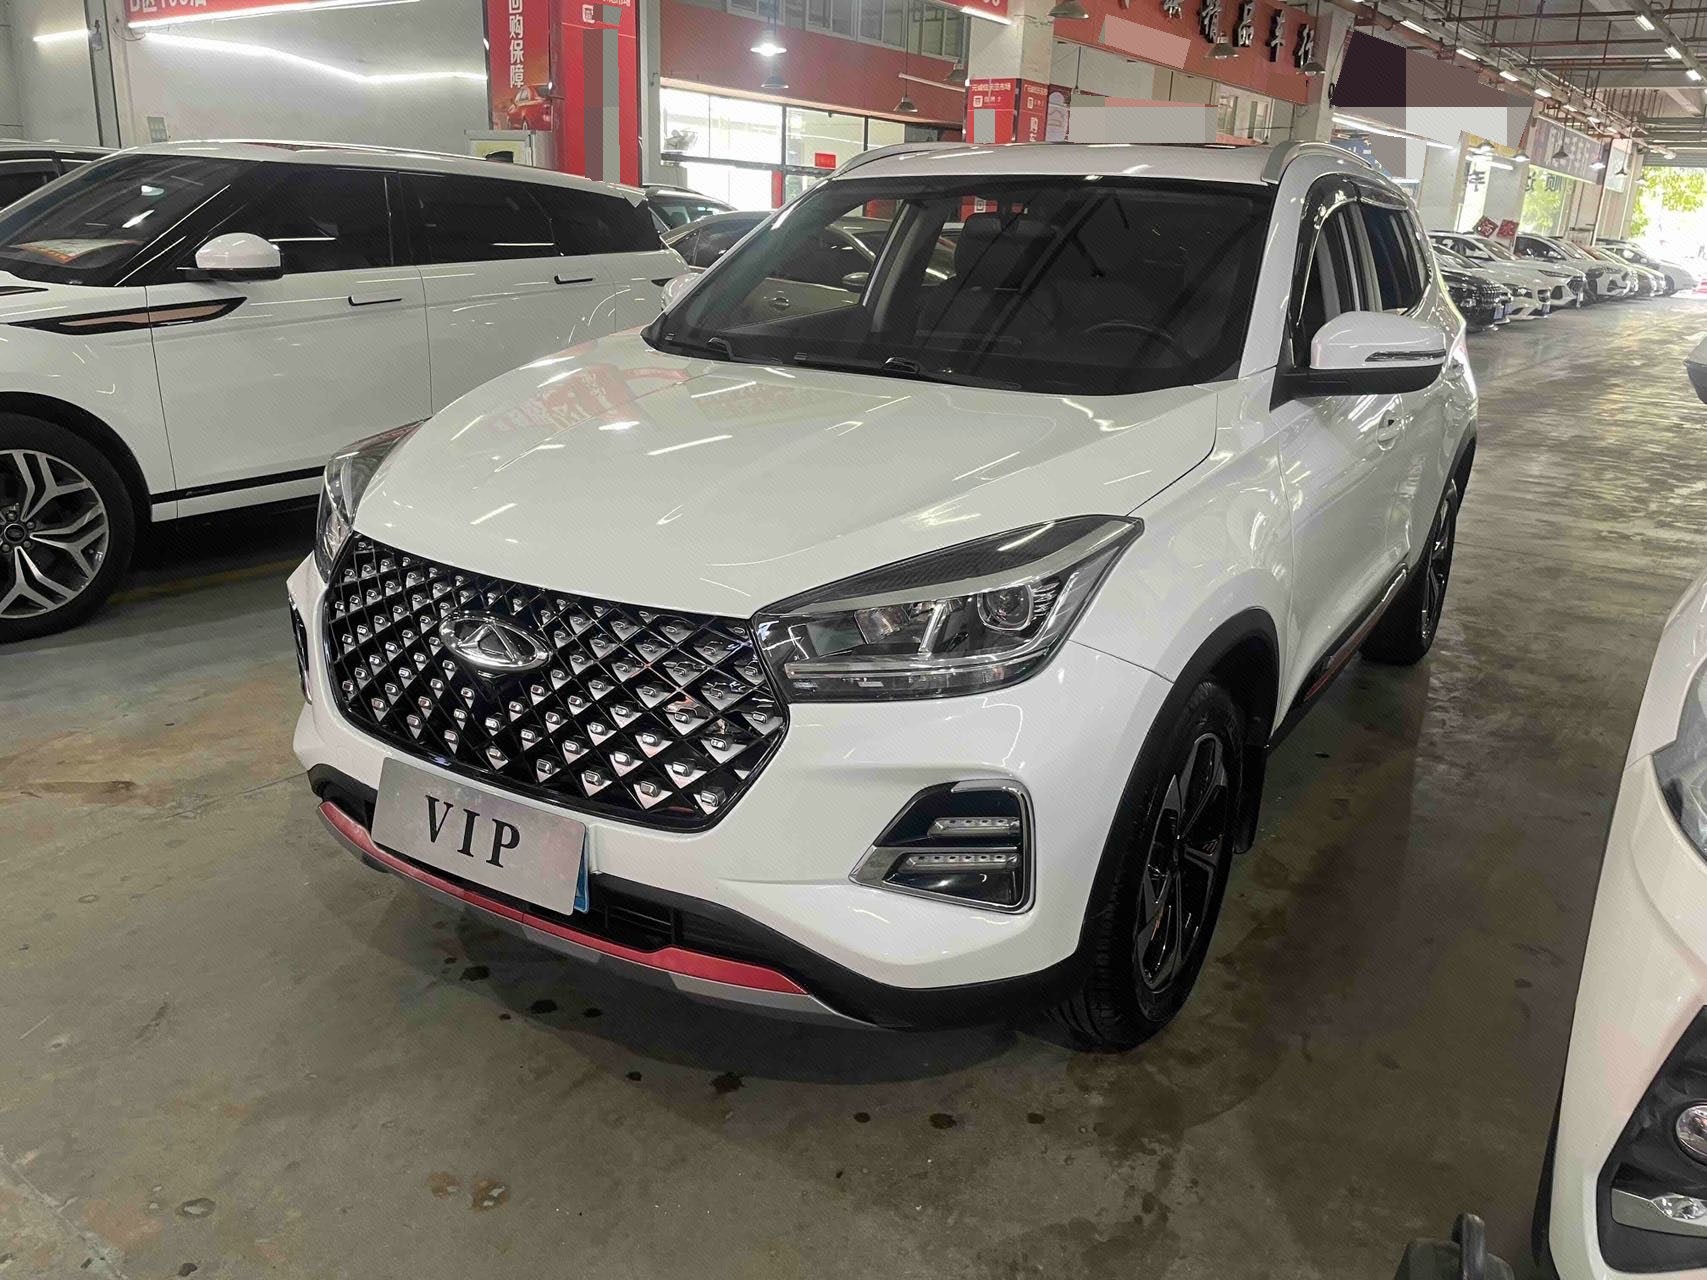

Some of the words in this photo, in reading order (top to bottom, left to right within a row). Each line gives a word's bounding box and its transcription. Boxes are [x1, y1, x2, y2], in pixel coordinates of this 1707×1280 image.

[508, 0, 524, 88] 回购保障
[425, 794, 520, 868] VIP
